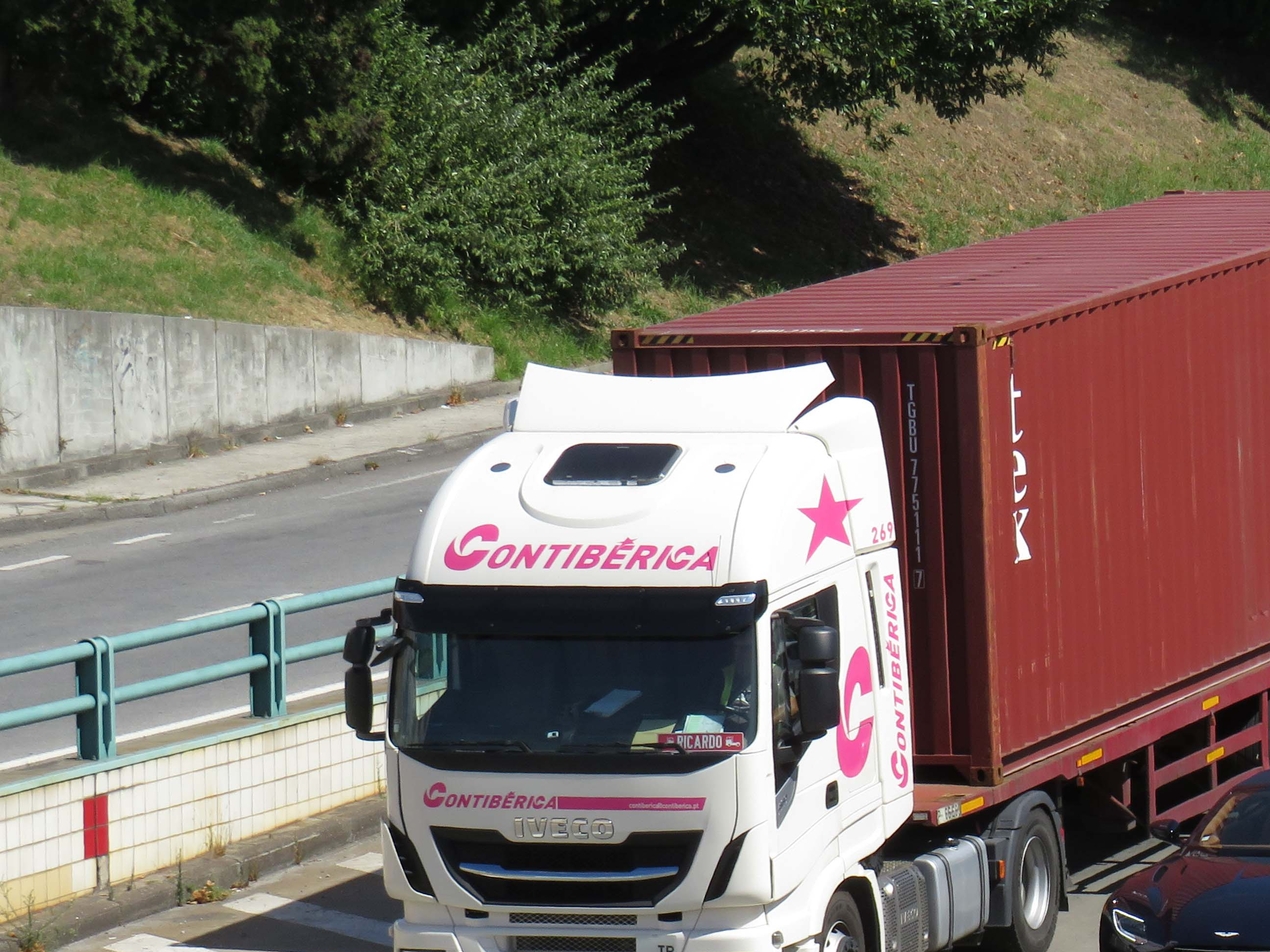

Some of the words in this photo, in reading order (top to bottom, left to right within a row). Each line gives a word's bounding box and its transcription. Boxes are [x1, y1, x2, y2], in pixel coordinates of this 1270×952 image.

[906, 383, 918, 454] TGBU
[910, 458, 922, 563] 775111
[871, 521, 894, 544] 269
[443, 523, 719, 572] CONTIBÉRICA
[914, 570, 926, 589] 7
[883, 573, 909, 788] CONTIBÉRICA
[677, 734, 722, 749] RICARDO
[422, 781, 558, 810] CONTIBÉRICA
[513, 816, 615, 840] IVECO
